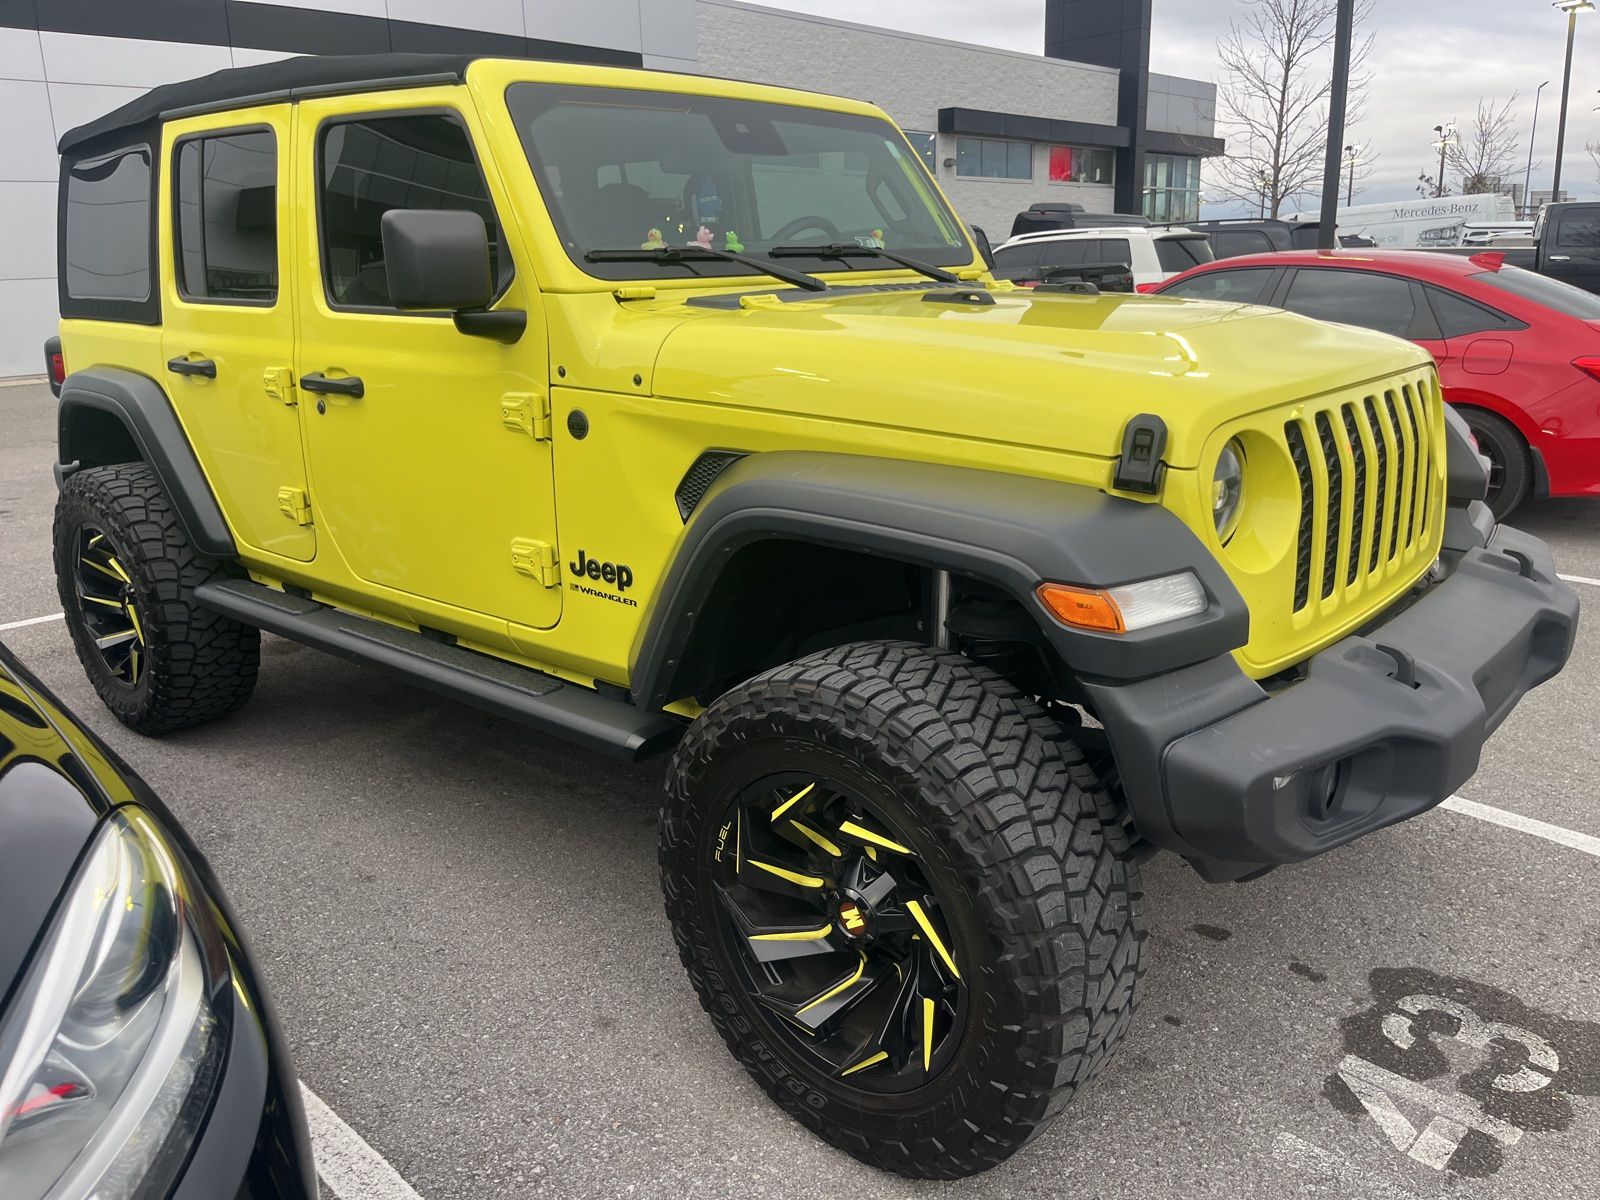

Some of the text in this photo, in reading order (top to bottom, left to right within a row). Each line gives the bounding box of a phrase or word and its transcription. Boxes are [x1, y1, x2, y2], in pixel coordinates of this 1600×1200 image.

[1393, 202, 1480, 220] Mercedes-Benz
[569, 549, 633, 592] Jeep
[580, 585, 637, 607] WRANGLER
[714, 821, 731, 862] FUEL
